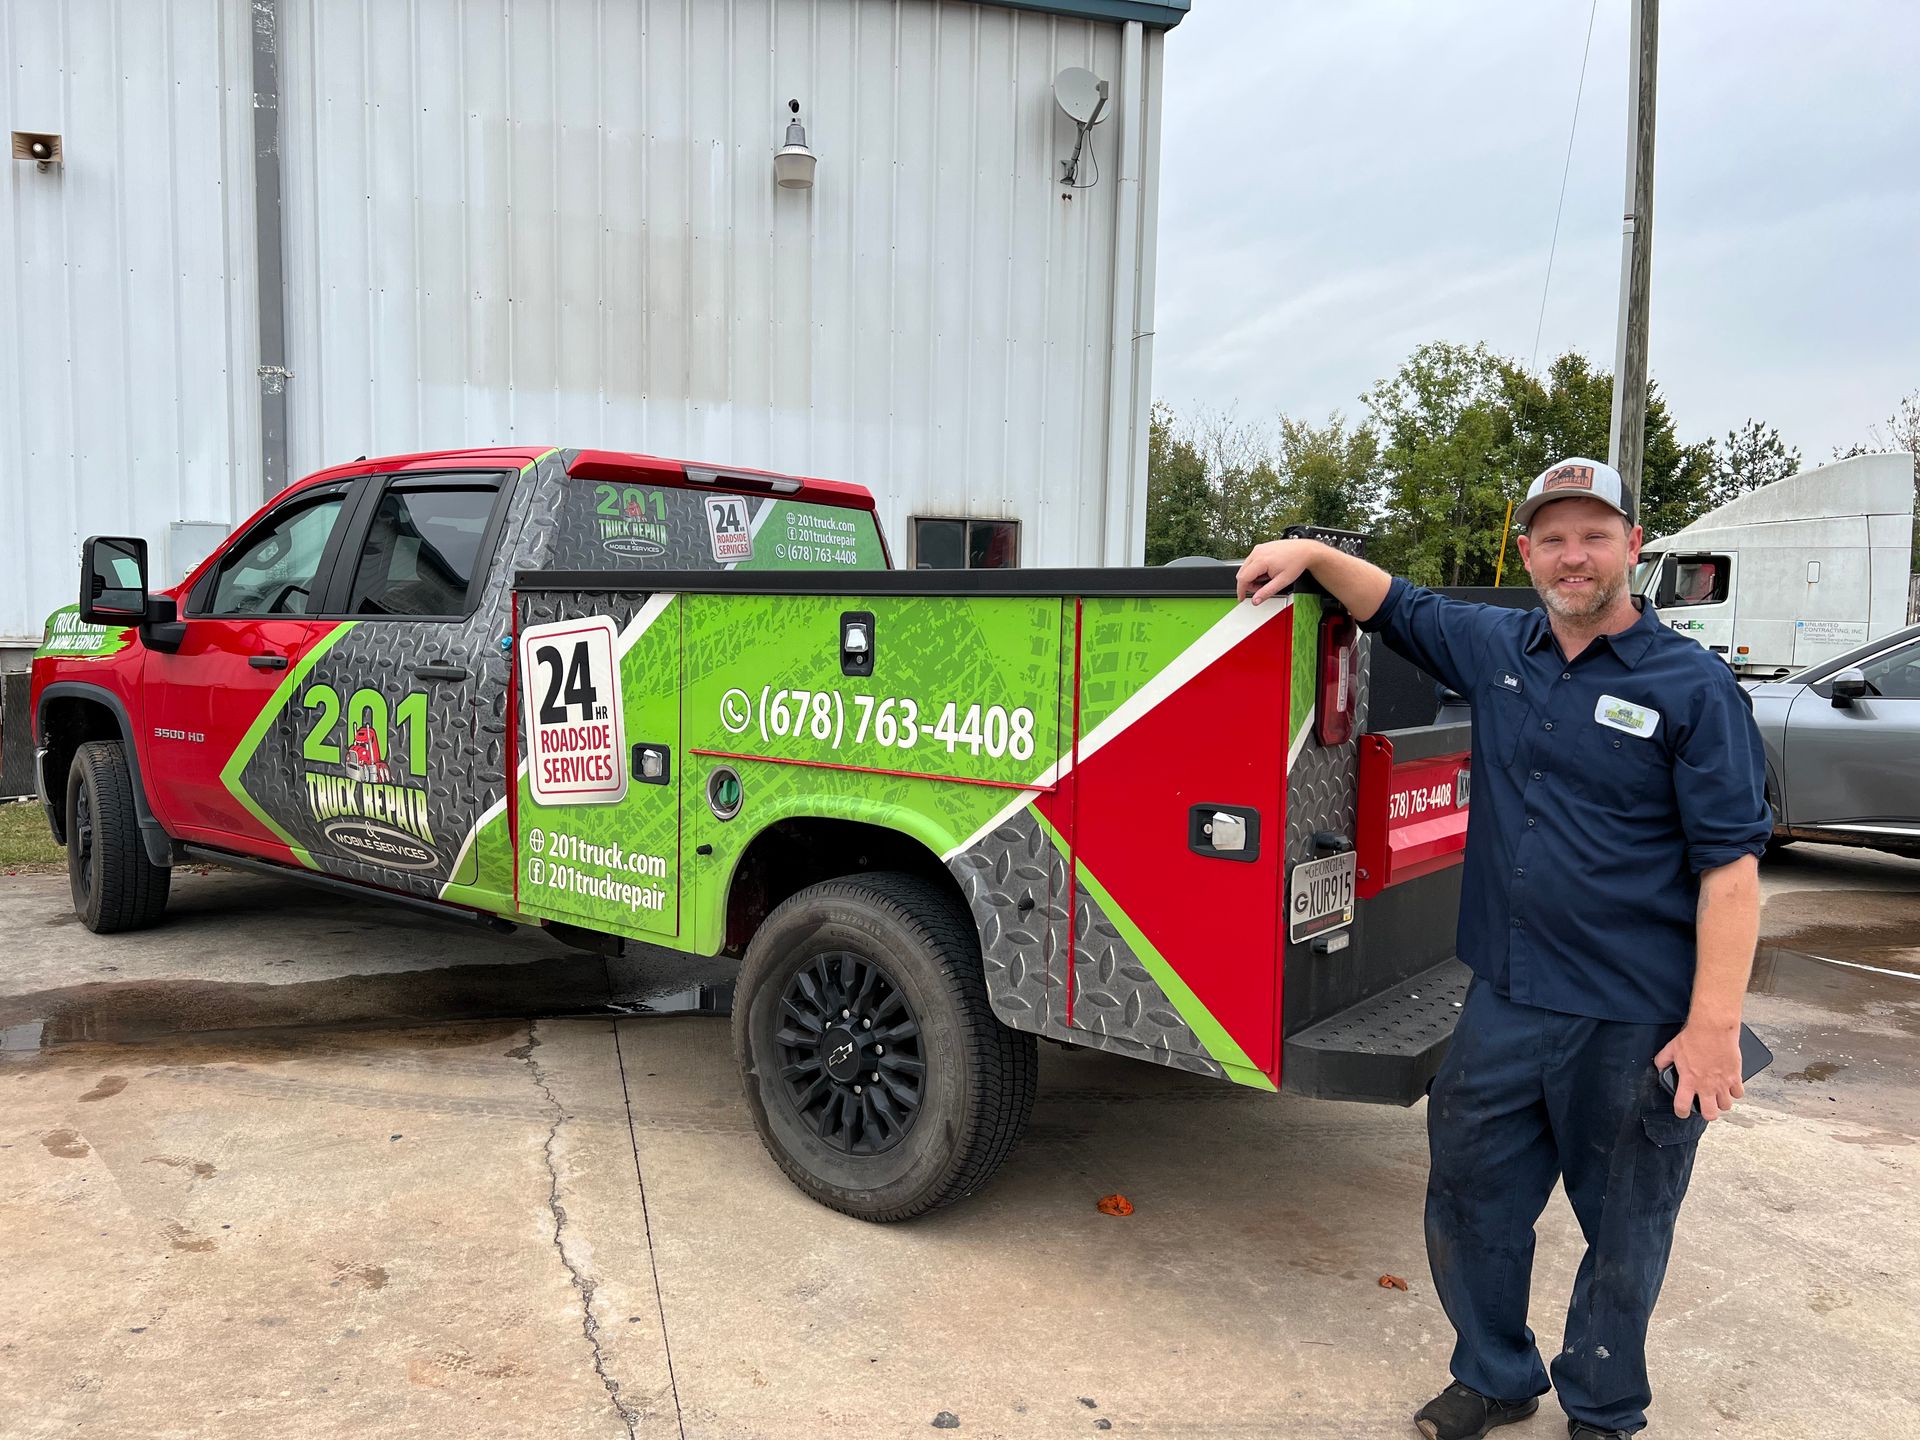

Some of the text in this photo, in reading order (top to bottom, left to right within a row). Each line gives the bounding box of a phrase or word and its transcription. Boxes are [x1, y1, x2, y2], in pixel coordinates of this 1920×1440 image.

[595, 484, 666, 521] 201
[598, 518, 667, 546] TRUCK REPAIR
[712, 503, 740, 533] 24
[797, 513, 856, 532] 201truck.com
[609, 543, 660, 553] MOBILE SERVICES
[716, 533, 747, 544] ROADSIDE
[718, 543, 749, 555] SERVICES
[798, 528, 856, 549] 201truckrepair
[787, 543, 857, 565] (678) 763-4408
[53, 612, 80, 633] TRUCK
[1671, 619, 1705, 630] FedEx
[75, 634, 105, 650] SERVICES
[536, 641, 608, 725] 24 HR
[154, 727, 204, 743] 3500 HD
[303, 684, 428, 777] 201
[759, 685, 1035, 761] (678) 763-4408
[540, 725, 611, 753] ROADSIDE
[544, 755, 613, 784] SERVICES
[305, 772, 436, 847] TRUCK REPAIR
[1389, 783, 1452, 819] 678) 763-4408
[364, 820, 380, 840] &
[335, 832, 428, 860] MOBILE SERVICES
[548, 831, 667, 878] 201truck.com
[1309, 858, 1344, 878] GEORGIA
[548, 862, 666, 913] 201truckrepair
[1309, 871, 1351, 918] XUR915
